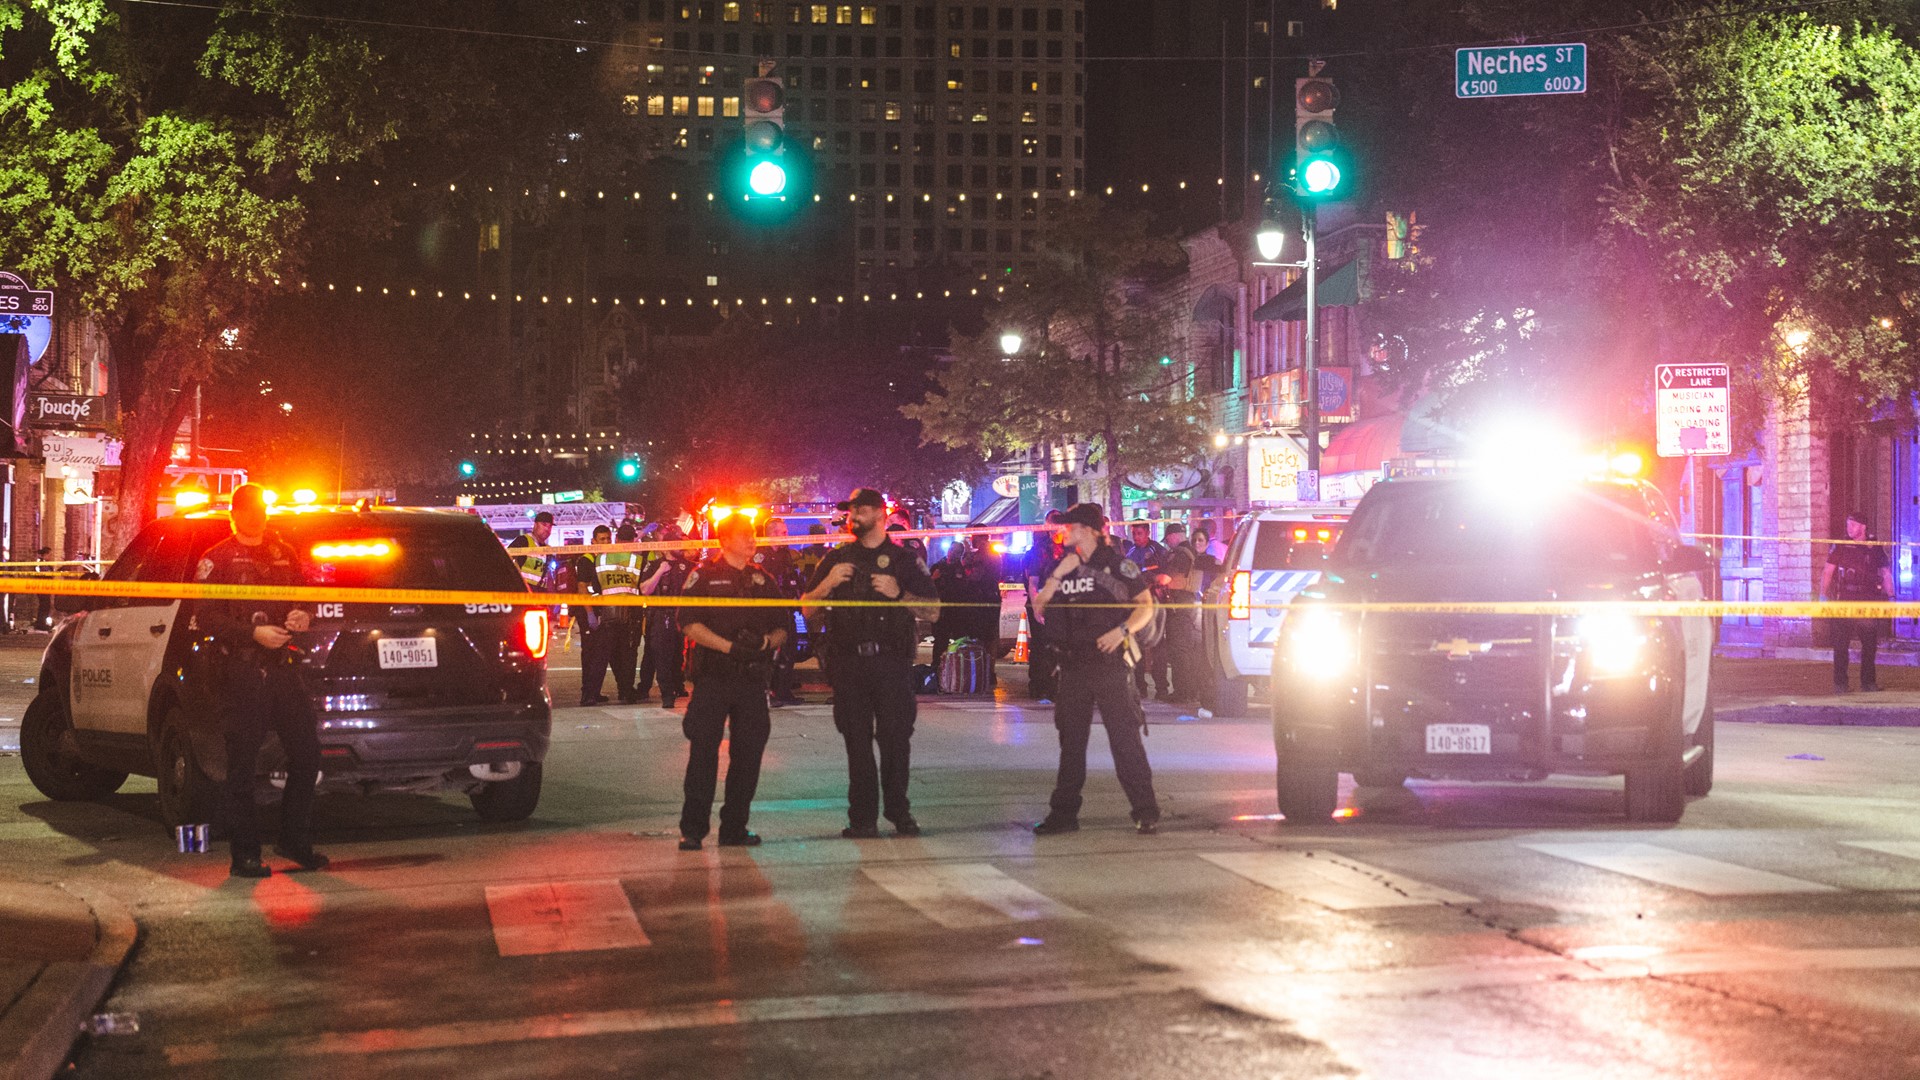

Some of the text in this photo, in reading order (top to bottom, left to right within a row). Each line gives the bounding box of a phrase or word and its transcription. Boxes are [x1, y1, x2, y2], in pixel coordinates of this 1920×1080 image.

[1468, 48, 1573, 75] Neches ST
[1471, 77, 1571, 94] 500 600
[1675, 368, 1727, 377] RESTRICTED
[1690, 378, 1713, 387] LANE
[1672, 391, 1715, 400] MUSICIAN
[37, 397, 94, 421] Touché
[1708, 404, 1726, 413] AND
[1673, 418, 1720, 428] NLOADING
[1262, 447, 1299, 468] Lucky
[606, 573, 632, 585] FIRE
[82, 669, 112, 682] POLICE
